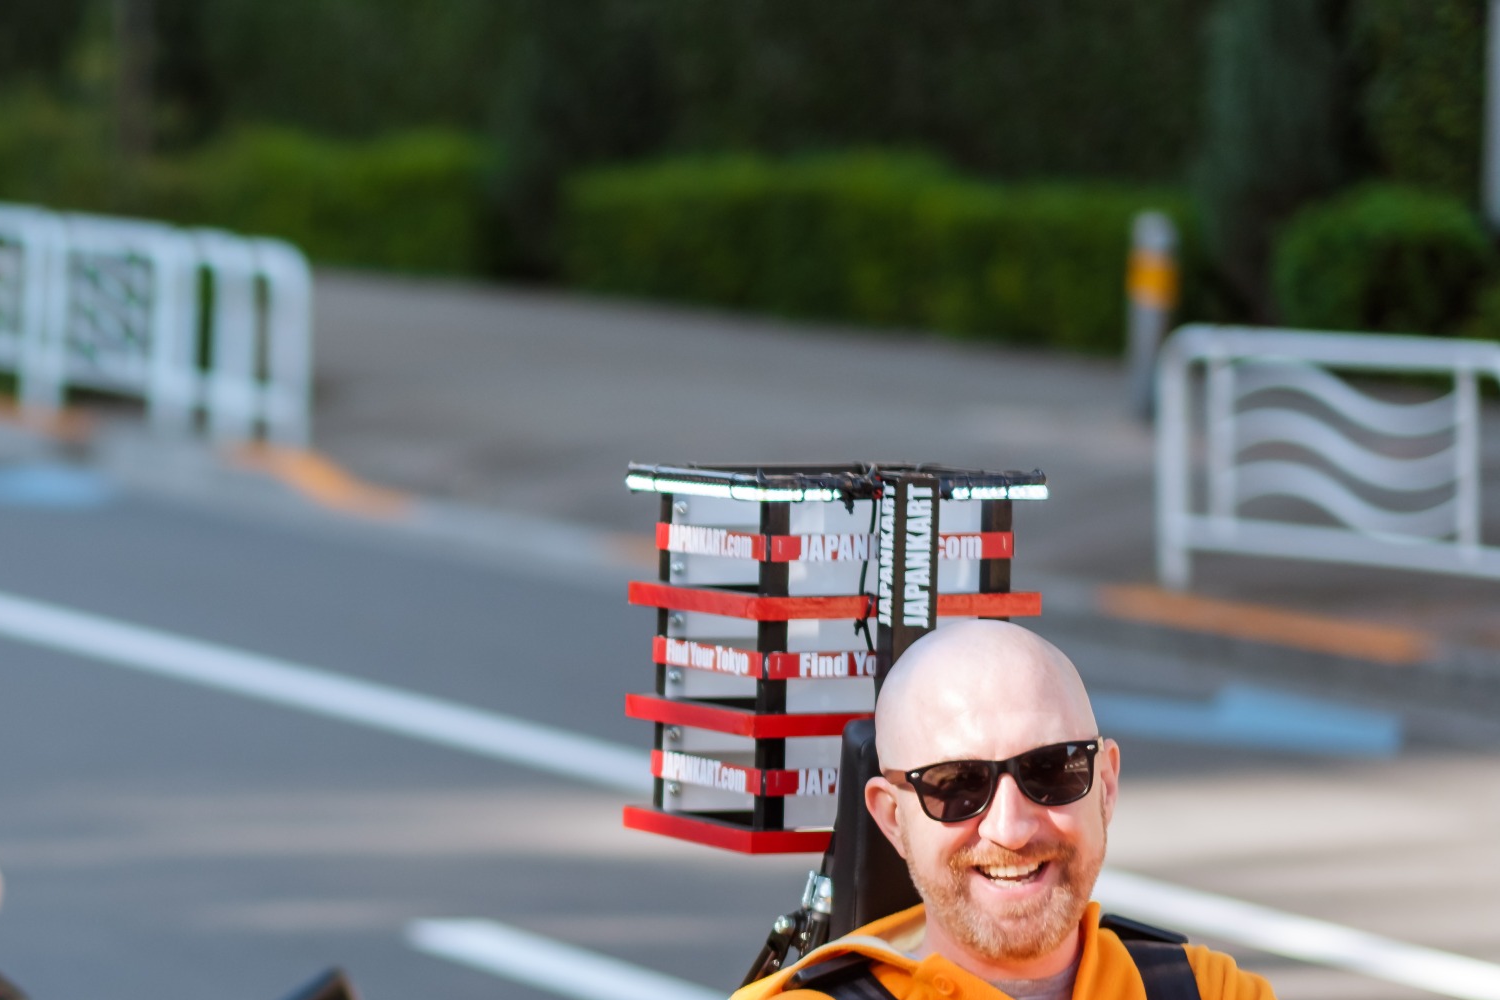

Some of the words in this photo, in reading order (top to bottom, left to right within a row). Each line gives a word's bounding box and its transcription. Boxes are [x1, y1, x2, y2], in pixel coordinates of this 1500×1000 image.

[667, 524, 753, 559] JAPANKART.com
[878, 481, 896, 628] JAPANKART
[903, 483, 934, 629] JAPANKART
[666, 637, 689, 664] Find
[689, 641, 715, 668] Your
[715, 644, 749, 676] Tokyo
[799, 651, 848, 678] Find
[662, 750, 747, 793] JAPANKART.com
